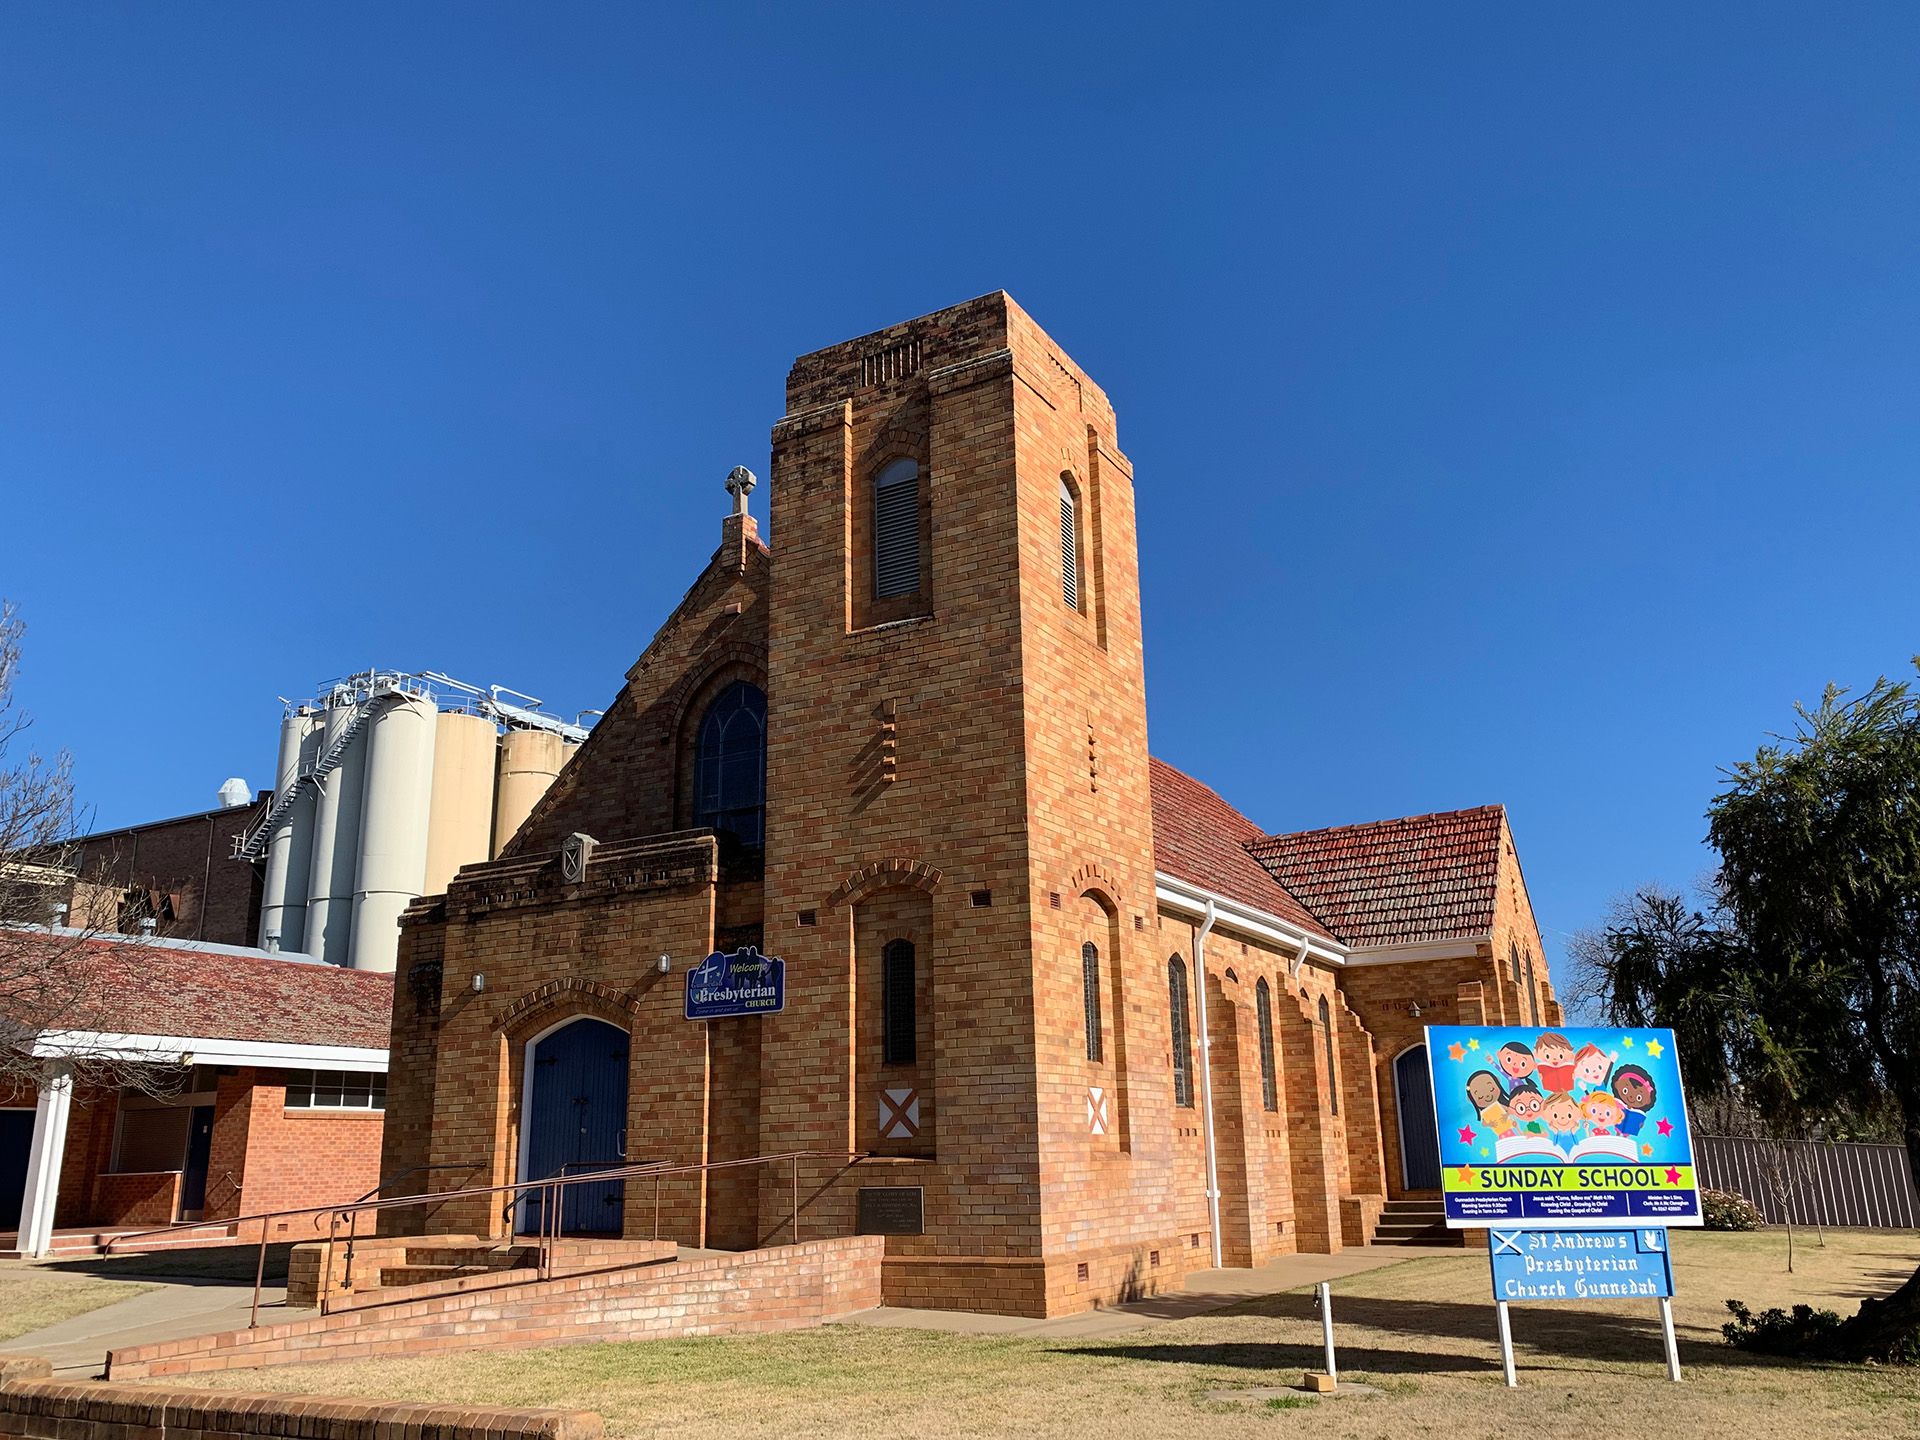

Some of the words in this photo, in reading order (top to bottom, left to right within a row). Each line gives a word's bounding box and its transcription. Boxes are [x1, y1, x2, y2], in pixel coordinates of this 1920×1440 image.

[730, 963, 768, 973] Welcome
[700, 984, 776, 1002] Presbyterian
[745, 998, 776, 1008] CHURCH
[1480, 1169, 1564, 1189] SUNDAY
[1579, 1168, 1660, 1187] SCHOOL
[1528, 1231, 1549, 1250] St
[1524, 1253, 1638, 1275] Presbyterian
[1505, 1279, 1567, 1297] Church
[1575, 1278, 1657, 1297] Gunnedah
